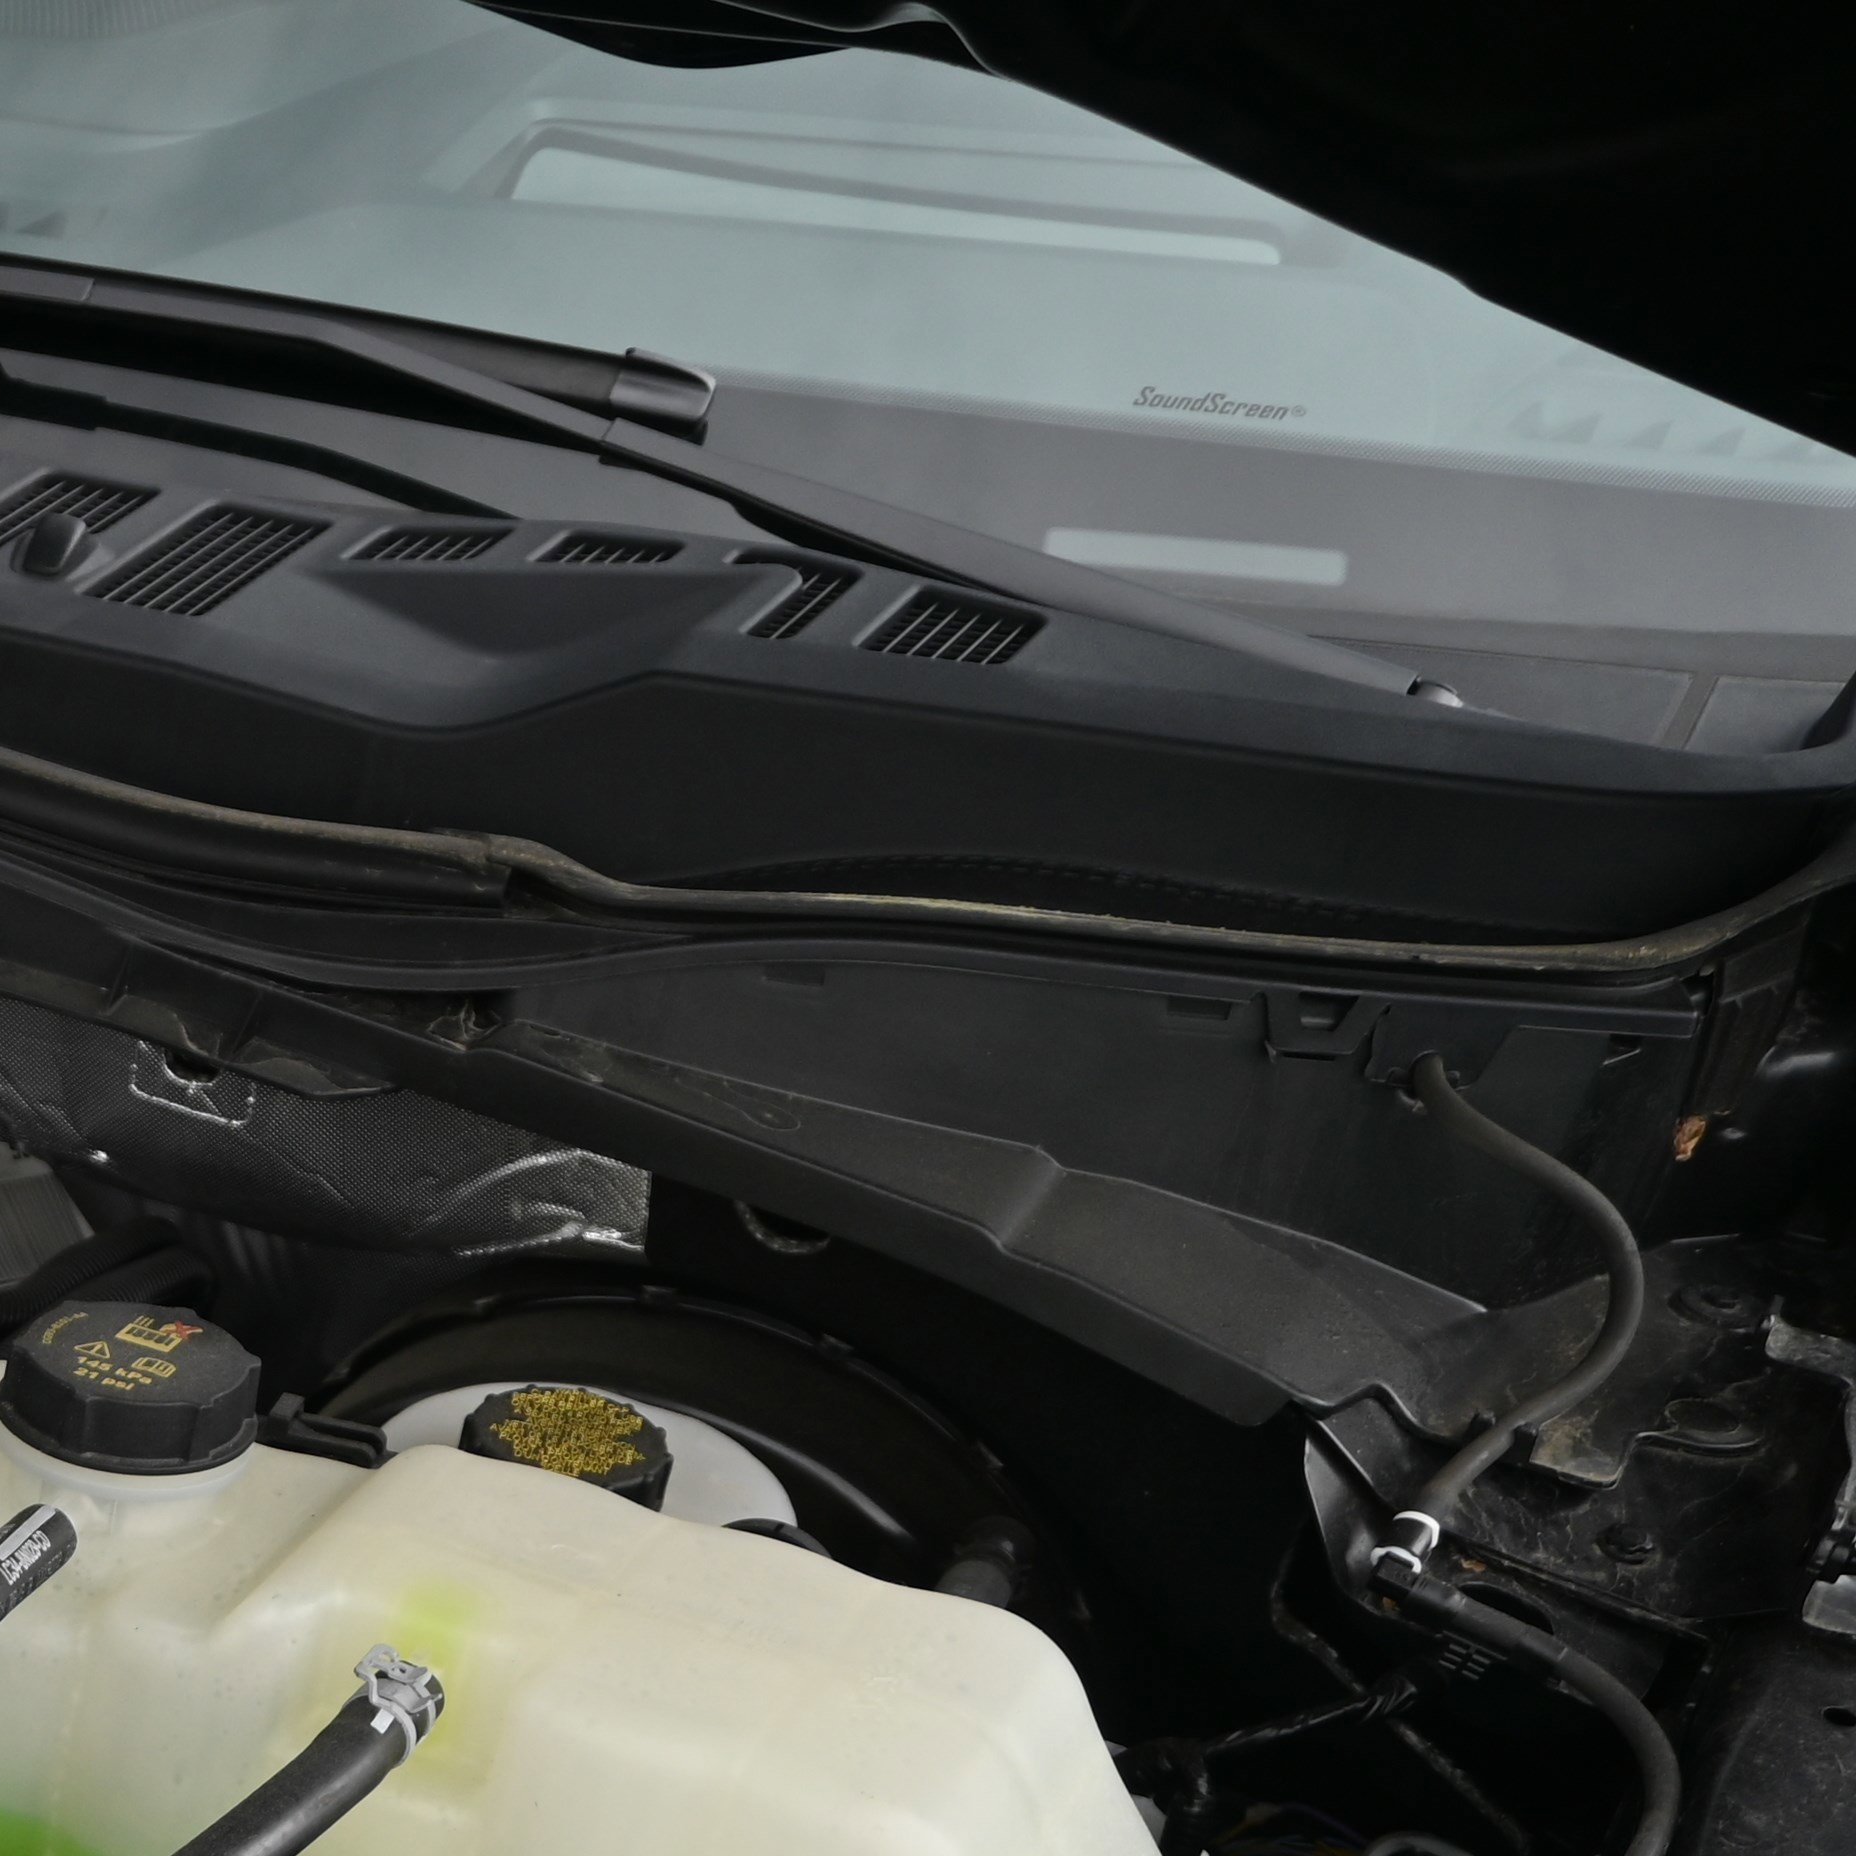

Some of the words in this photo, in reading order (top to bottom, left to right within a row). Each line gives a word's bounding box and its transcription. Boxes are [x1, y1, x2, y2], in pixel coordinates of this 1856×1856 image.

[73, 1366, 100, 1380] 21
[101, 1376, 136, 1391] psi
[76, 1355, 114, 1372] 145
[114, 1367, 153, 1385] kPa
